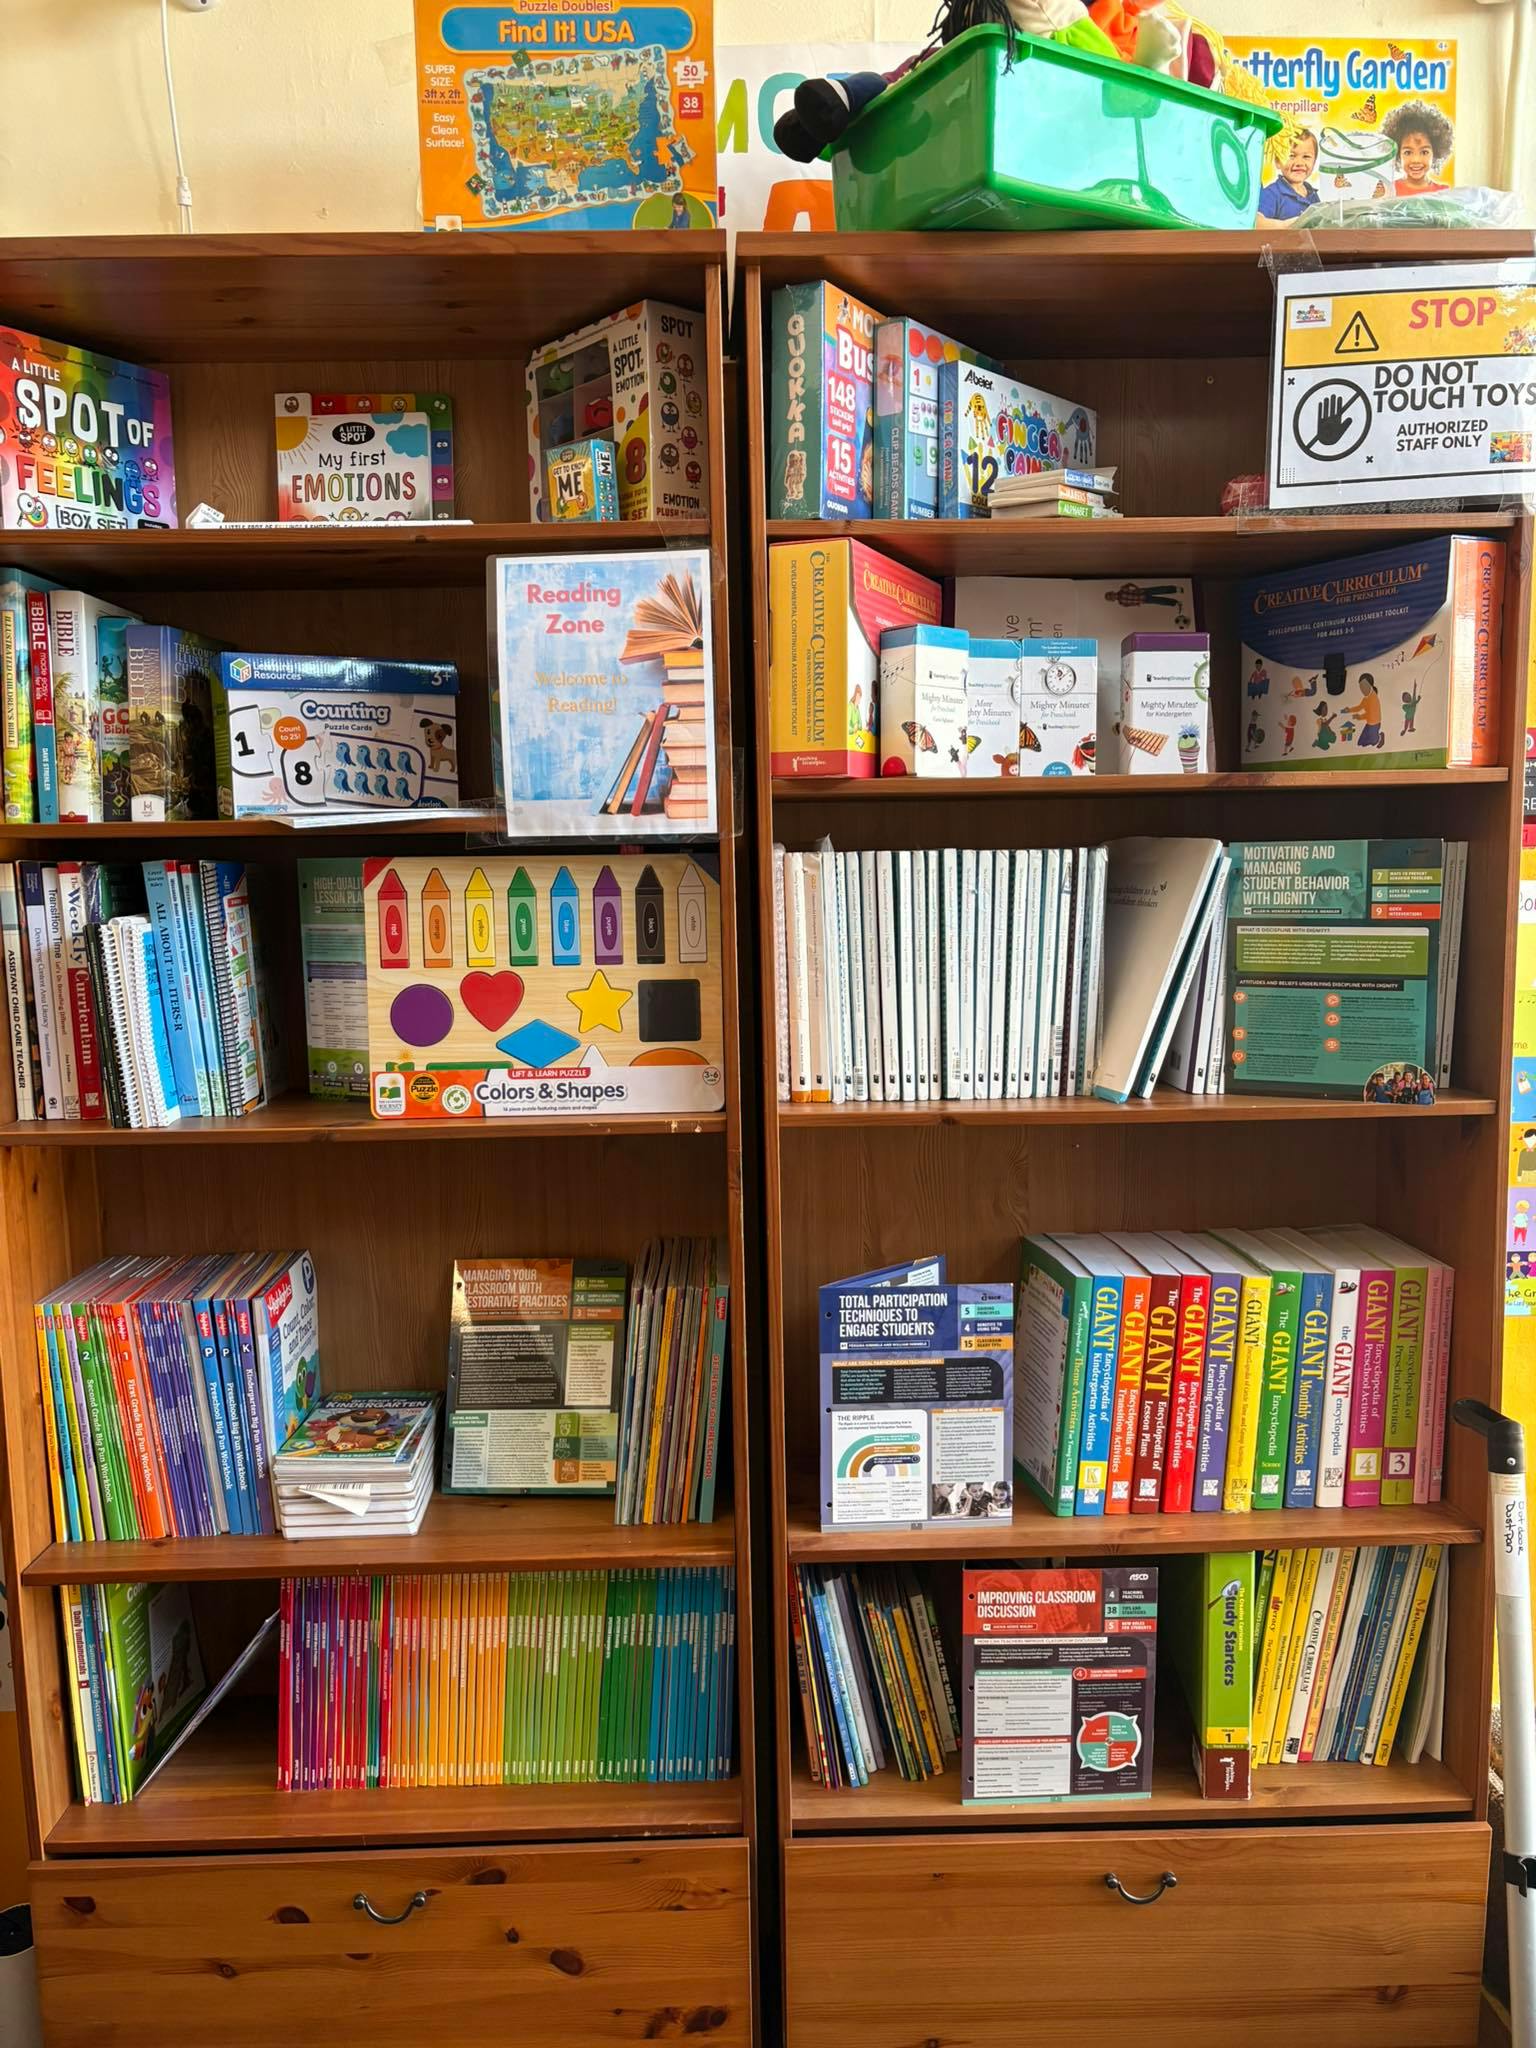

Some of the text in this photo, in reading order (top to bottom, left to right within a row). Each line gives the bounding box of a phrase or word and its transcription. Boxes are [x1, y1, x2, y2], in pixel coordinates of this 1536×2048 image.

[520, 1, 613, 11] Puzzle Doubles!
[499, 21, 635, 42] Find It! USA
[425, 65, 455, 74] SUPER
[683, 66, 698, 77] 50
[1347, 51, 1446, 90] Garden
[431, 77, 454, 87] SIZE:
[683, 97, 699, 109] 38
[433, 113, 455, 124] Easy
[432, 125, 458, 135] Clean
[426, 138, 465, 148] Surface!
[1409, 297, 1497, 329] STOP
[662, 315, 693, 338] SPOT
[613, 334, 639, 352] A LITTLE
[12, 358, 61, 382] A LITTLE
[787, 314, 805, 443] QUOKKA
[1375, 361, 1479, 389] DO NOT
[828, 377, 856, 411] 148
[1373, 382, 1536, 413] TOUCH TOYS
[16, 379, 154, 447] SPOT OF
[341, 433, 366, 442] SPOT
[997, 413, 1062, 461] FINGER
[1396, 419, 1488, 436] AUTHORIZED
[1396, 434, 1482, 452] STAFF ONLY
[318, 451, 386, 470] My first
[626, 437, 646, 484] 8
[832, 440, 851, 473] 15
[966, 452, 999, 494] 12
[16, 455, 161, 517] FEELINGS
[292, 472, 416, 503] EMOTIONS
[558, 472, 583, 499] ME
[663, 493, 700, 509] EMOTION
[527, 583, 621, 607] Reading
[810, 550, 825, 634] CREATIVE
[1253, 563, 1423, 615] CREATIVE CURRICULUM
[32, 607, 45, 650] BIBLE
[56, 610, 74, 657] BIBLE
[546, 614, 605, 634] Zone
[431, 671, 451, 686] 3+
[534, 671, 629, 687] Welcome to
[301, 700, 390, 722] Counting
[547, 697, 618, 715] Reading!
[1030, 701, 1088, 711] Mighty Minutes
[1141, 700, 1196, 711] Mighty Minutes
[1159, 711, 1192, 719] Kindergarten
[294, 761, 313, 786] 8
[1244, 846, 1335, 860] MOTIVATING AND
[1244, 861, 1301, 875] MANAGING
[1376, 872, 1383, 881] 7
[1243, 876, 1349, 890] STUDENT BEHAVIOR
[1243, 892, 1316, 905] WITH DIGNITY
[67, 877, 92, 1065] The Weekly Curriculum
[155, 902, 182, 1031] ALL ABOUT THE ITERS-R
[7, 949, 26, 1089] ASSISTANT CHILD CARE TEACHER
[537, 1069, 558, 1077] LEARN
[559, 1069, 587, 1077] PUZZLE
[477, 1082, 625, 1102] Colors & Shapes
[463, 1269, 536, 1281] MANAGING YOUR
[464, 1282, 542, 1294] CLASSROOM WITH
[576, 1294, 584, 1302] 24
[839, 1293, 948, 1308] TOTAL PARTICIPATION
[840, 1308, 918, 1323] TECHNIQUES TO
[1093, 1287, 1118, 1351] GIANT
[840, 1323, 934, 1337] ENGAGE STUDENTS
[1144, 1306, 1176, 1396] GIANT
[1100, 1353, 1113, 1421] Encyclopedia of
[1268, 1310, 1291, 1456] The GIANT Encyclopedia
[1330, 1326, 1353, 1456] the GIANT encyclopedia
[246, 1369, 265, 1479] Kindergarten Big Fun Workbook
[1140, 1401, 1154, 1457] Lesson Plans
[87, 1379, 113, 1503] Second Grade Big Fun Workbook
[210, 1382, 232, 1490] Preschool Big Fun Workbook
[978, 1590, 1095, 1604] IMPROVING CLASSROOM
[978, 1605, 1036, 1617] DISCUSSION
[73, 1610, 88, 1675] Daily Fundamentals
[1223, 1584, 1239, 1687] Study Starters
[1300, 1610, 1324, 1694] CREATIVE CURRICULUM
[1226, 1733, 1231, 1743] 1
